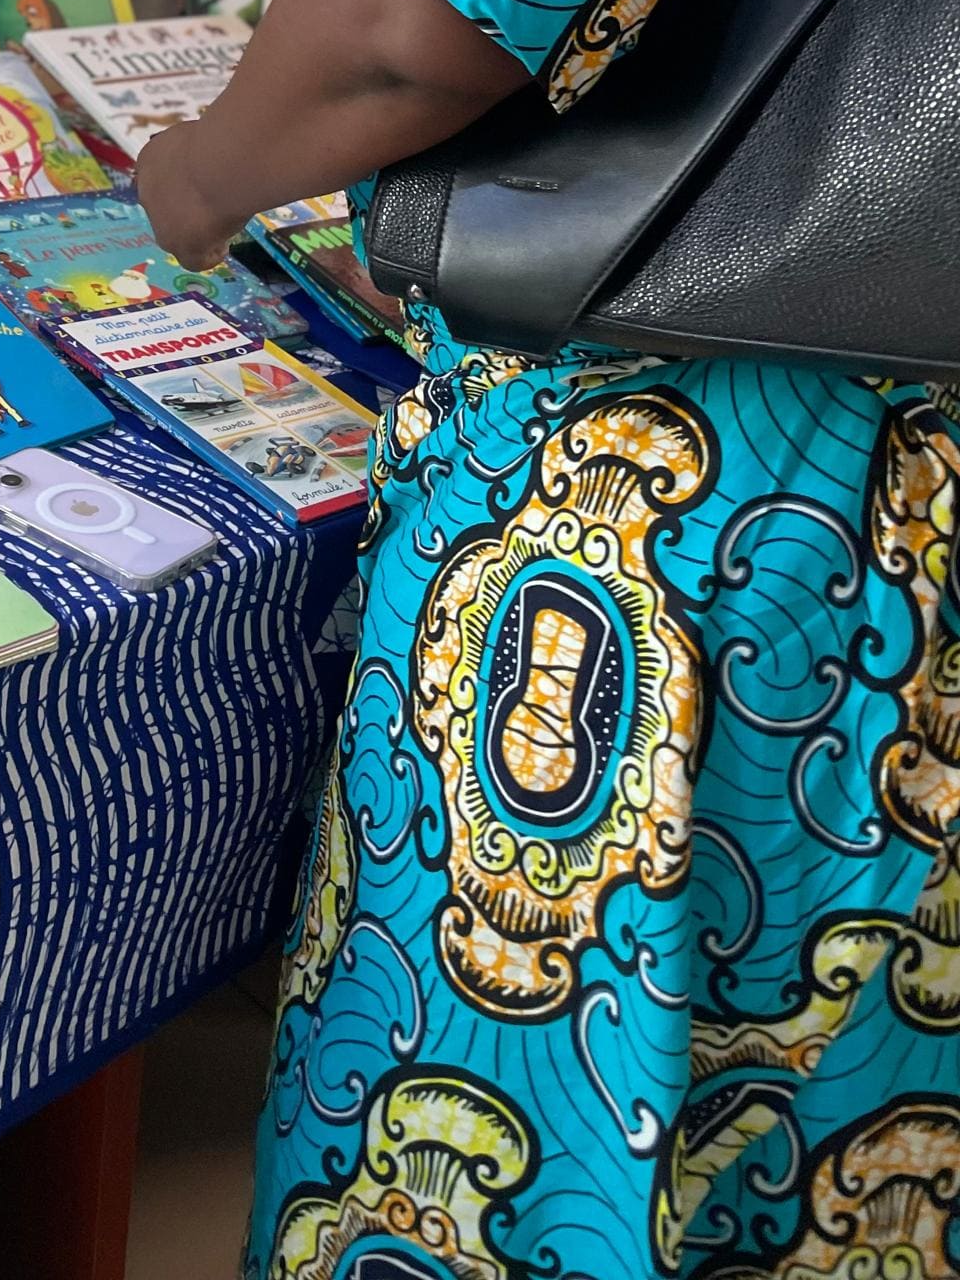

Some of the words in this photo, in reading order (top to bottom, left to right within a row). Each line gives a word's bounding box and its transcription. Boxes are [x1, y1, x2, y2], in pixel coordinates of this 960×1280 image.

[66, 41, 247, 78] L'imagie
[289, 223, 352, 254] MIN
[95, 323, 184, 345] dictionnaire
[185, 316, 209, 328] des
[96, 320, 137, 330] Mon
[138, 311, 172, 327] petit
[100, 327, 238, 363] TRANSPORTS
[147, 364, 159, 372] T
[235, 347, 247, 355] O
[213, 420, 256, 433] navette
[292, 482, 343, 505] formule
